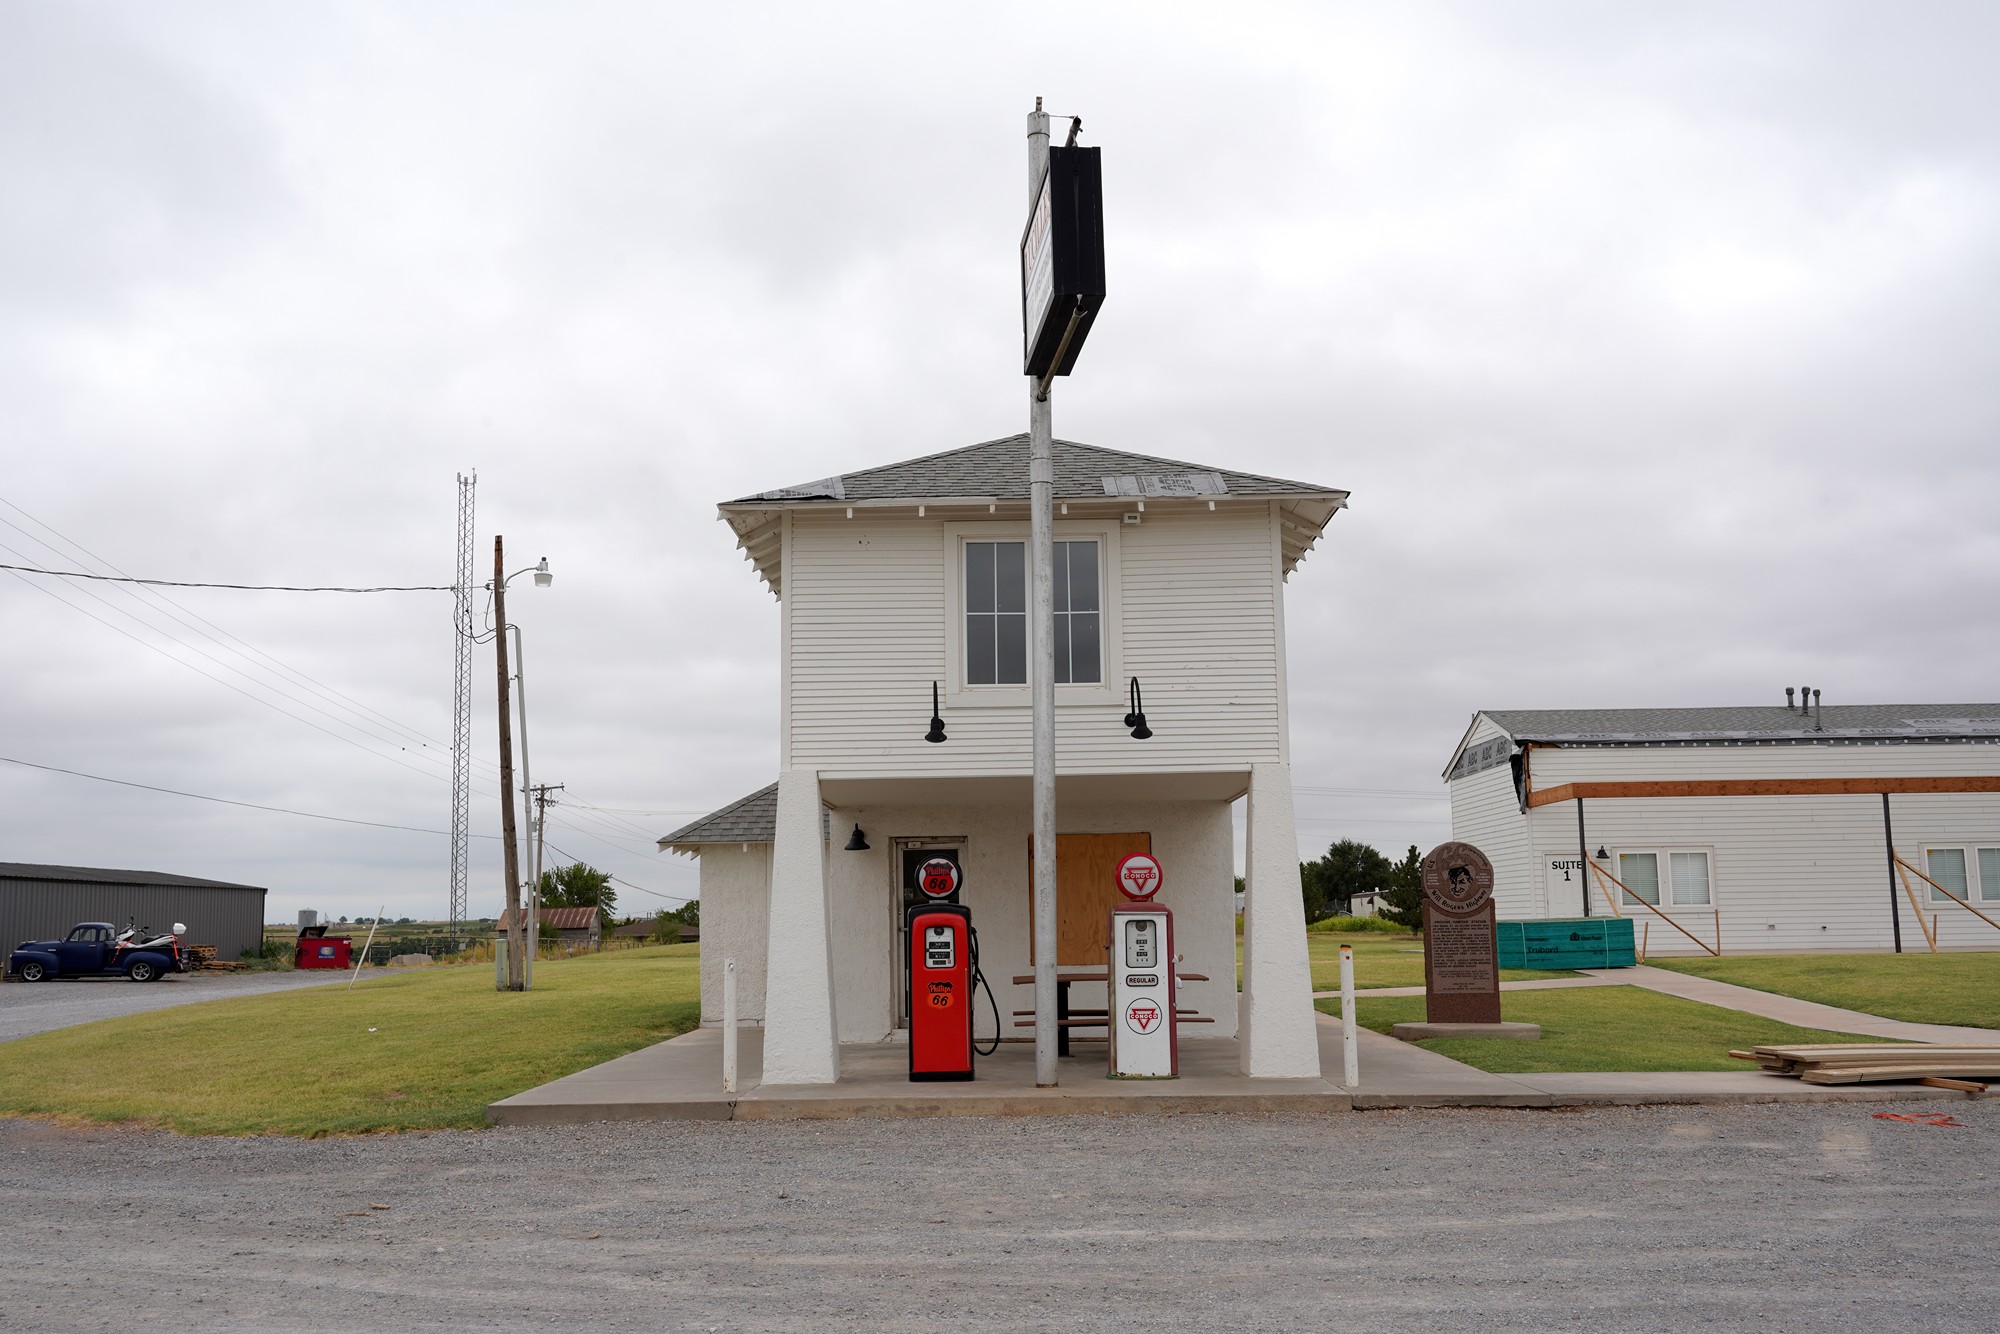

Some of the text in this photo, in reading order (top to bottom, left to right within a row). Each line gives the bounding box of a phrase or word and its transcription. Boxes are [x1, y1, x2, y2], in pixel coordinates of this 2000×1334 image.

[1551, 860, 1582, 870] SUITE
[926, 866, 950, 876] Phillips
[1563, 870, 1571, 881] 1
[929, 877, 948, 891] 66
[1431, 889, 1488, 911] Will Rogers Highway
[930, 984, 951, 994] Phillips
[932, 995, 949, 1007] 66
